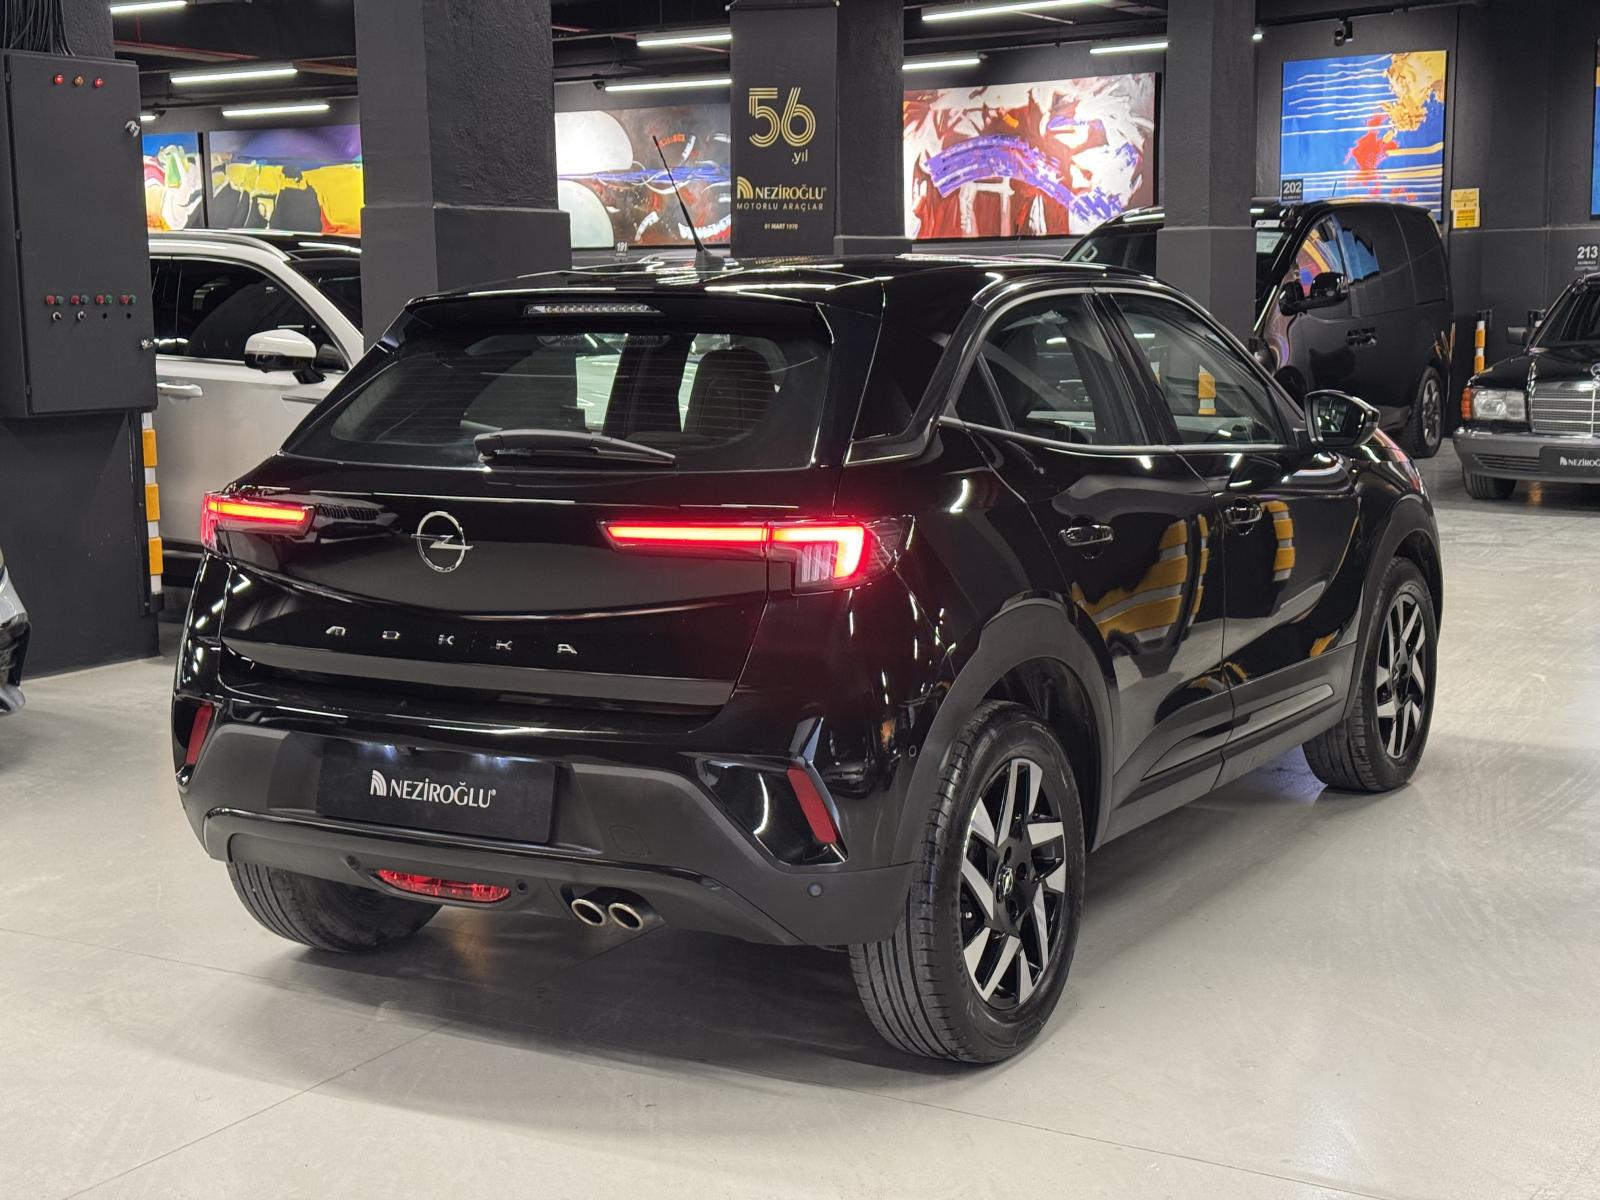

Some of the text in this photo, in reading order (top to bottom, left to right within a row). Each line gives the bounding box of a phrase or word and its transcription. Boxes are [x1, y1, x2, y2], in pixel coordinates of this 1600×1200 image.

[749, 87, 816, 147] 56
[755, 184, 824, 200] NEZİROĞLU
[1283, 181, 1302, 194] 202
[736, 203, 823, 212] MOTORLU ARAÇLAR
[1577, 246, 1598, 259] 213
[389, 777, 492, 808] NEZİROĞLU
